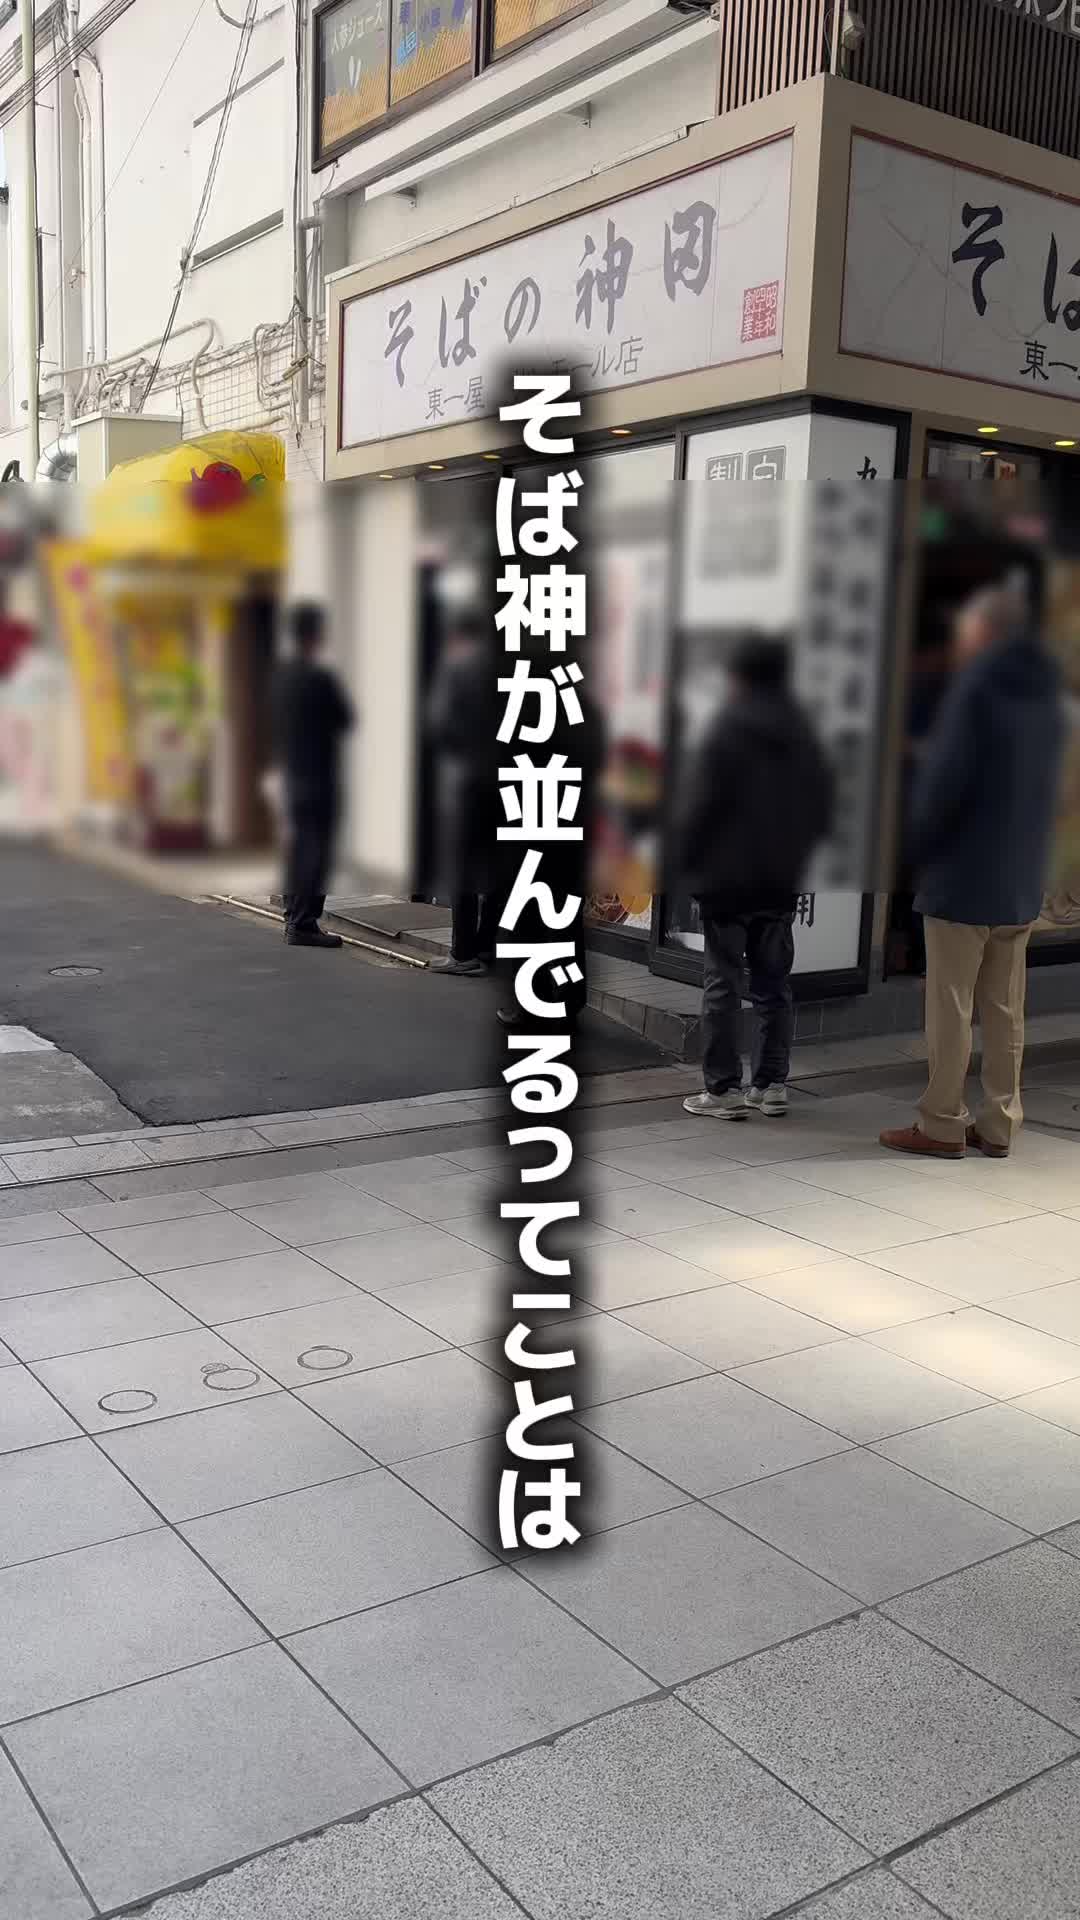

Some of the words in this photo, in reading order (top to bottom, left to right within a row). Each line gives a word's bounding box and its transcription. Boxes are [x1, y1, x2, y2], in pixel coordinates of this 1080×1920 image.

[1019, 339, 1080, 380] 東一
[425, 375, 485, 420] 東一屋
